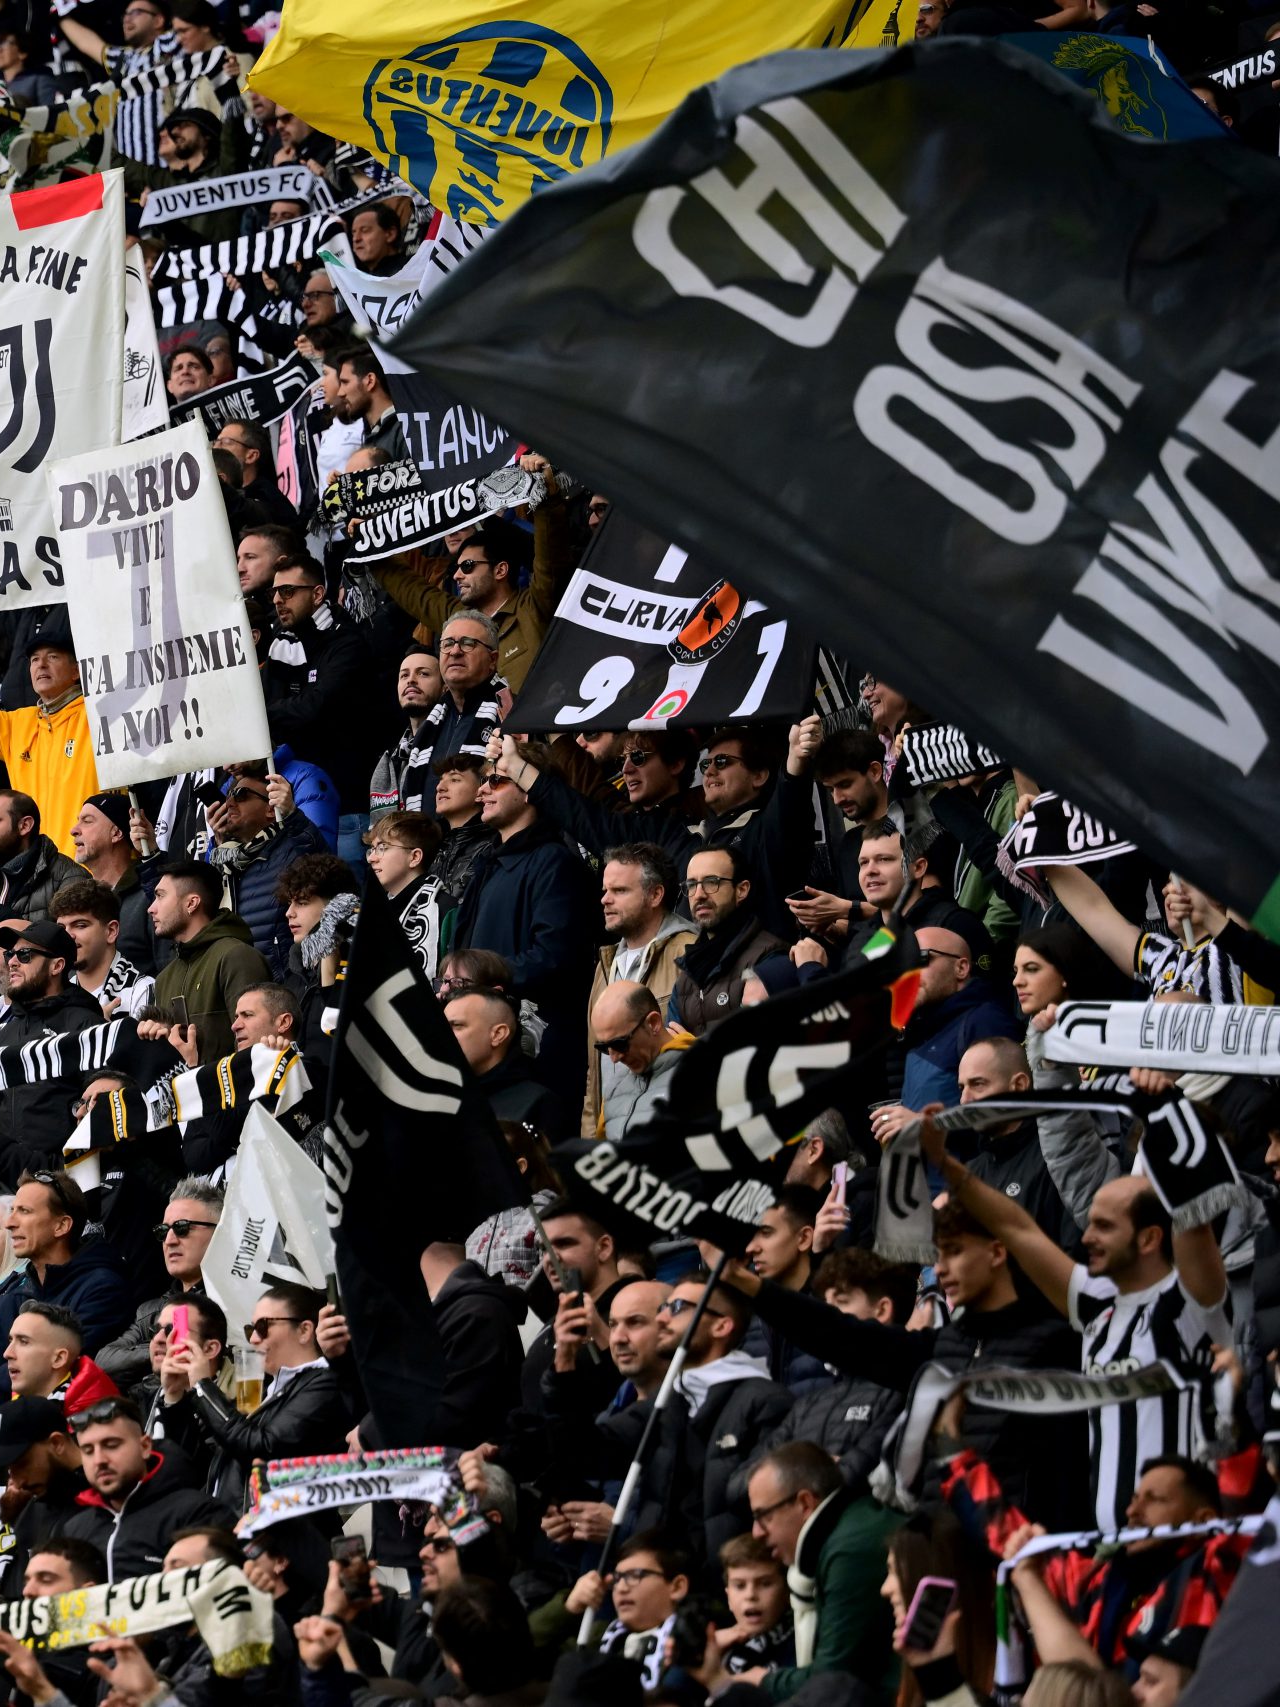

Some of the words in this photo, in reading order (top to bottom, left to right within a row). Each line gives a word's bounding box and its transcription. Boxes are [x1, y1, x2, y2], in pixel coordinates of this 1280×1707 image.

[154, 176, 269, 217] JUVENTUS
[279, 172, 305, 193] FC
[632, 97, 907, 348] CHI
[26, 246, 87, 294] FINE
[854, 256, 1143, 545] OSA
[59, 452, 200, 531] DARIO
[367, 464, 422, 497] FORZ
[355, 478, 476, 551] JUVENTUS
[112, 520, 165, 569] VIVE
[139, 585, 152, 626] E
[80, 654, 115, 698] FA
[124, 626, 247, 691] INSIEME
[96, 716, 115, 757] A
[122, 703, 174, 752] NOI
[111, 1090, 124, 1139] JUVENTUS
[306, 1474, 393, 1508] 2011-2012
